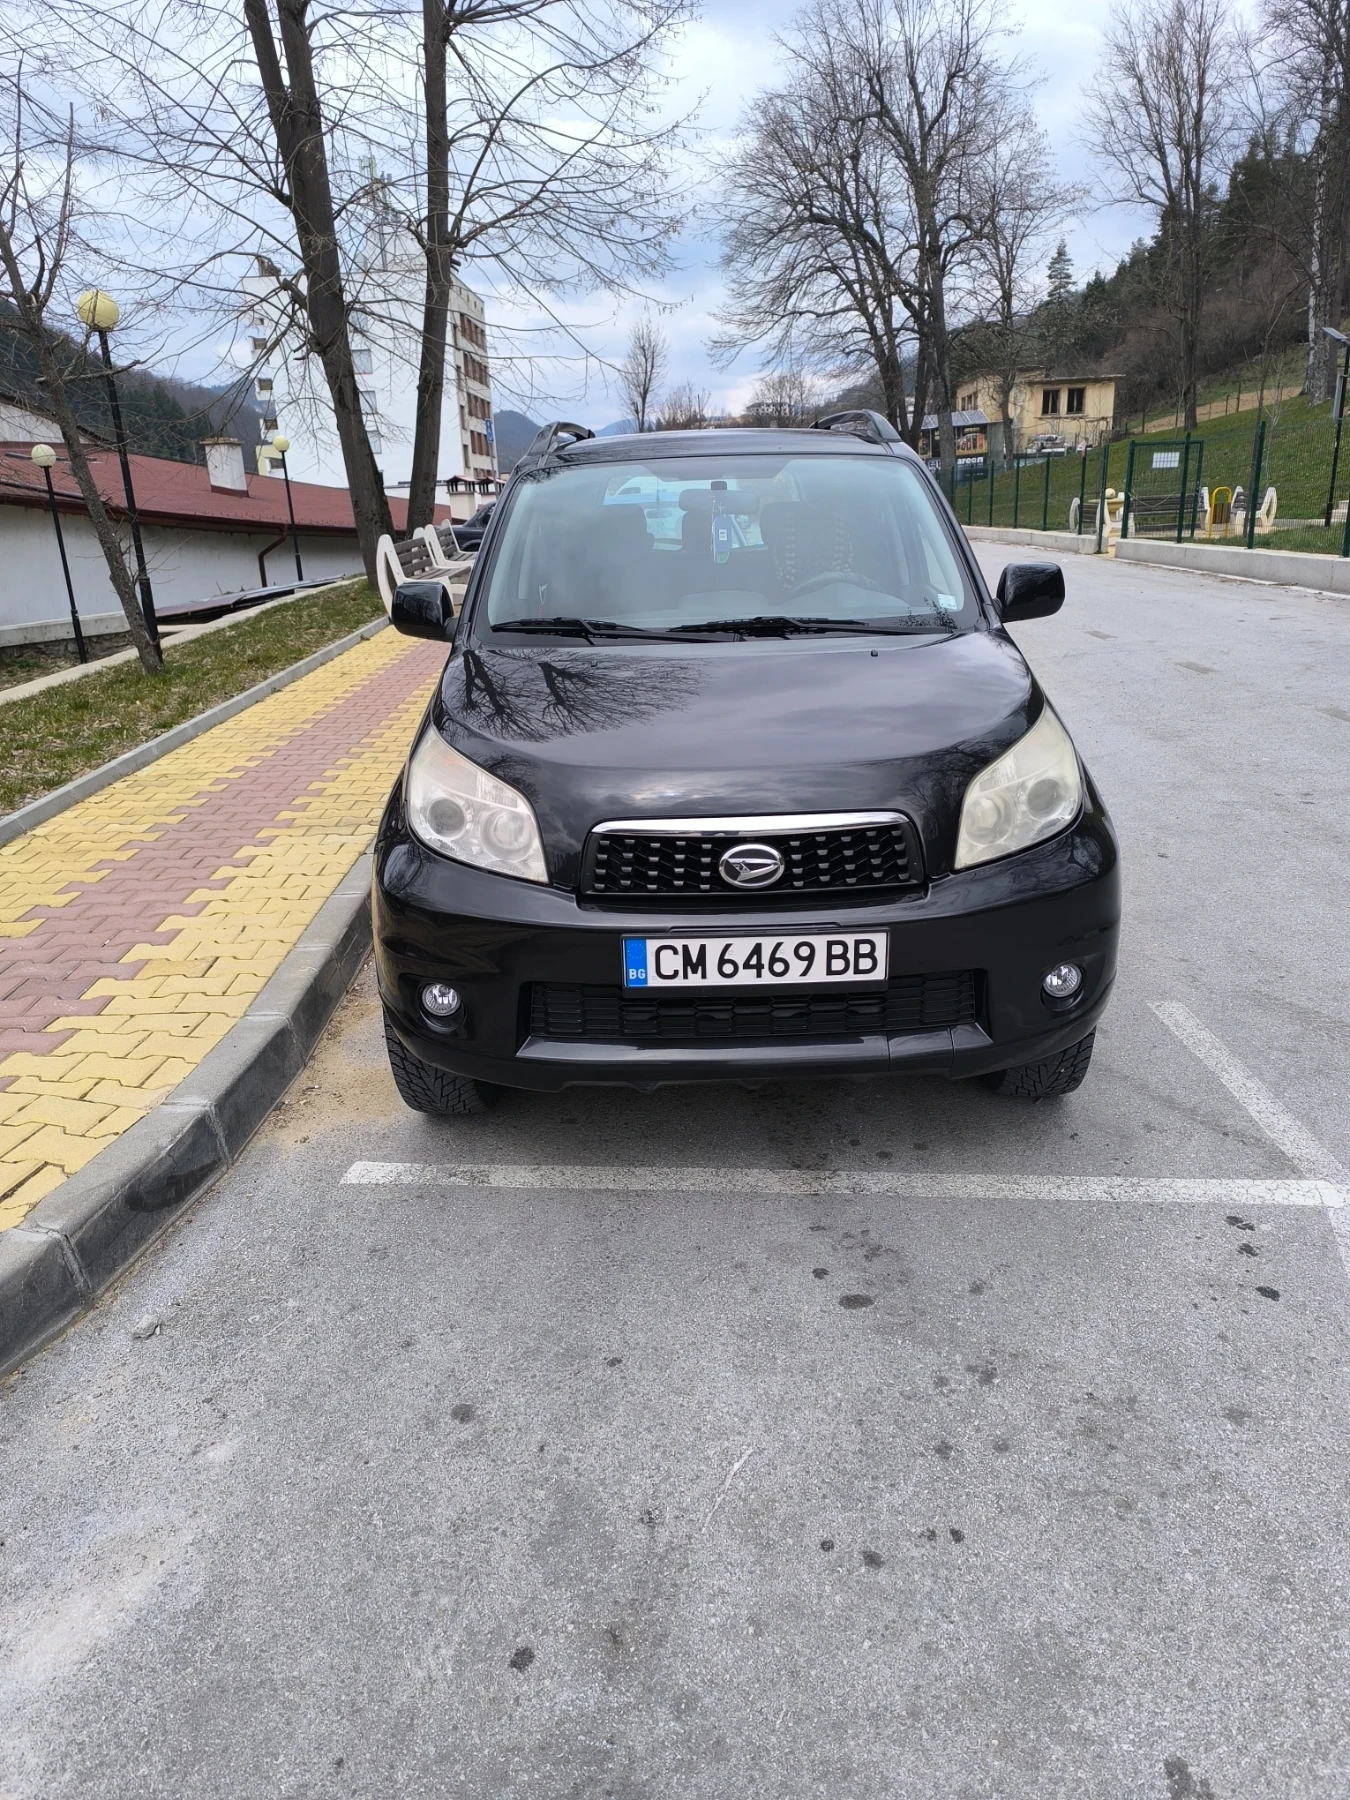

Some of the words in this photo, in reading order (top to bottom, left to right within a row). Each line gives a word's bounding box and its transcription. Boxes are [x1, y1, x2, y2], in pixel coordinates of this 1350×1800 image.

[957, 457, 983, 465] areon
[655, 944, 707, 981] CM
[717, 940, 816, 979] 6469
[825, 939, 878, 976] BB
[628, 968, 646, 980] BG
